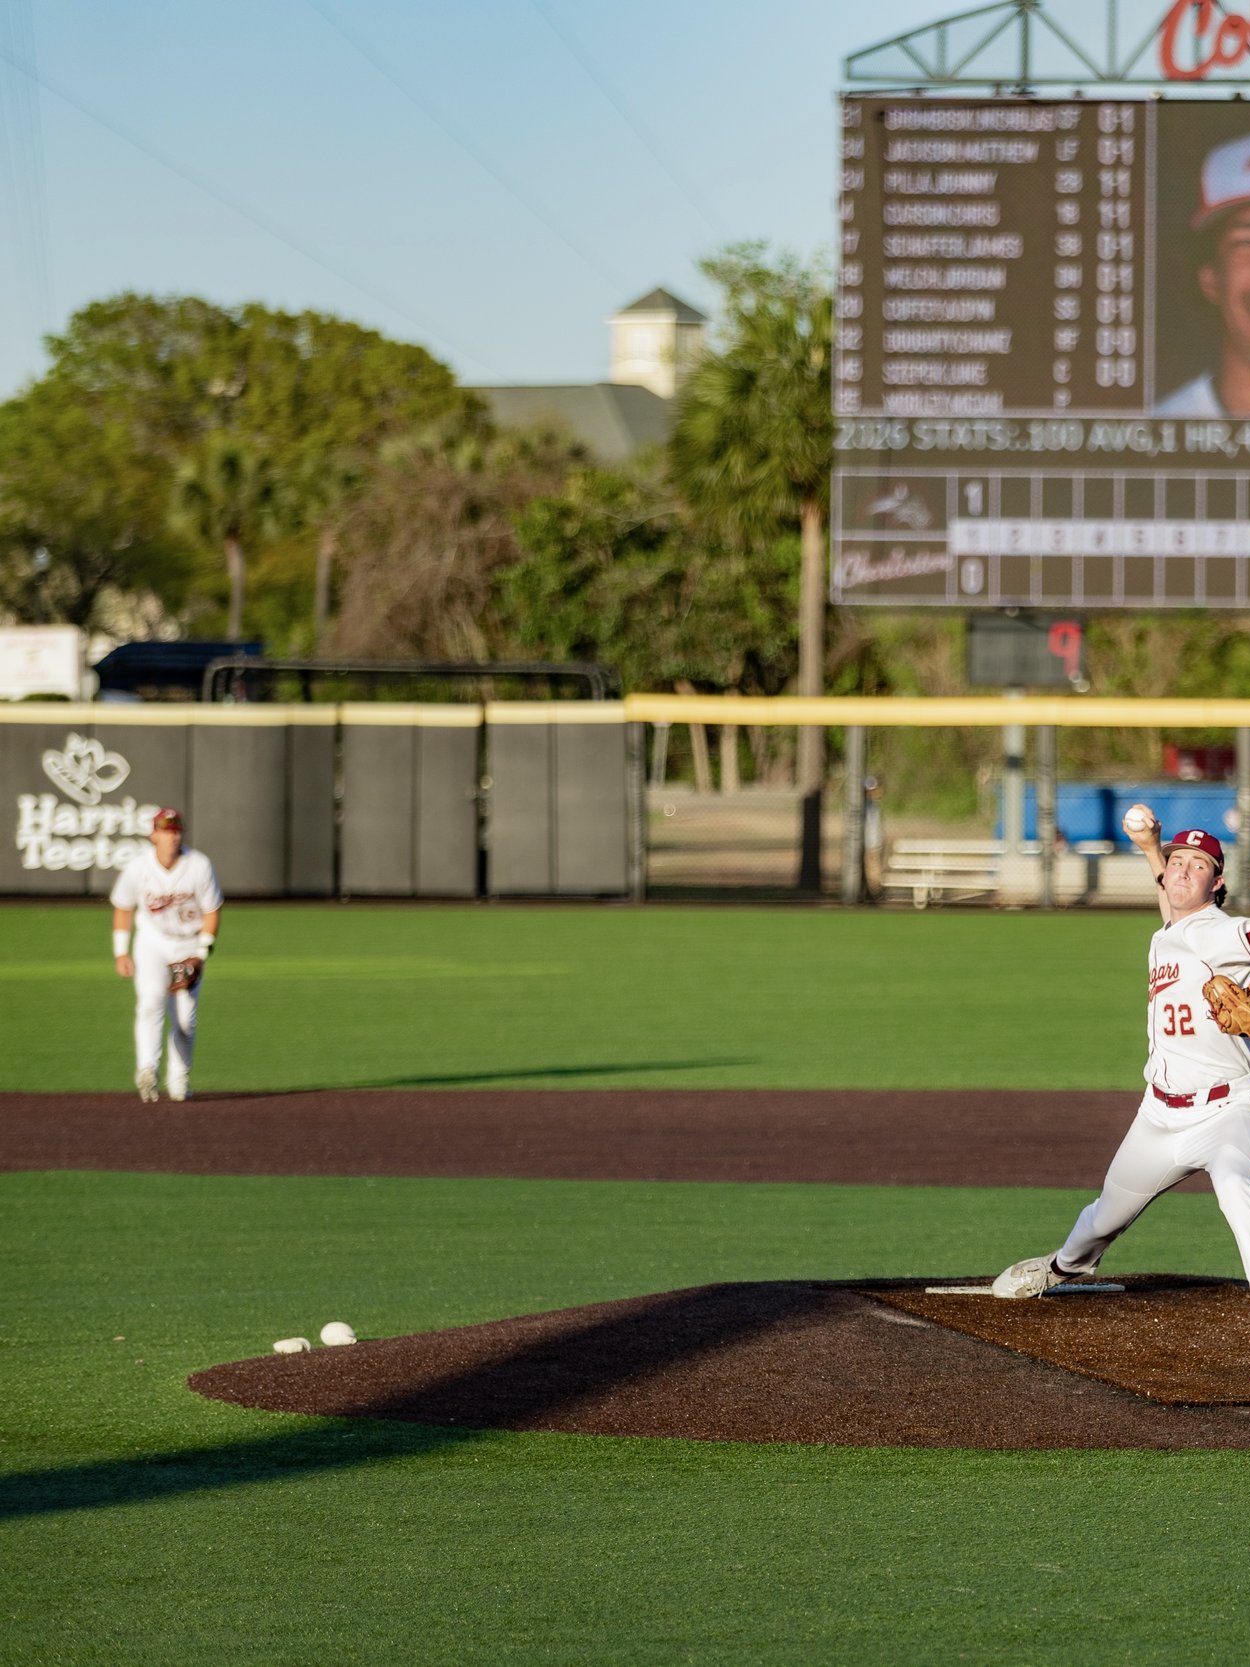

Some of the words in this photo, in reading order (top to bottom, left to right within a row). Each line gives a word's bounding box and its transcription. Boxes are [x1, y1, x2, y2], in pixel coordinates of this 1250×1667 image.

[964, 480, 983, 516] 1
[960, 558, 984, 595] 0
[1047, 619, 1082, 682] 9
[17, 793, 161, 837] Harris
[1186, 830, 1204, 847] C
[1149, 963, 1180, 985] gars
[1163, 1003, 1195, 1036] 32
